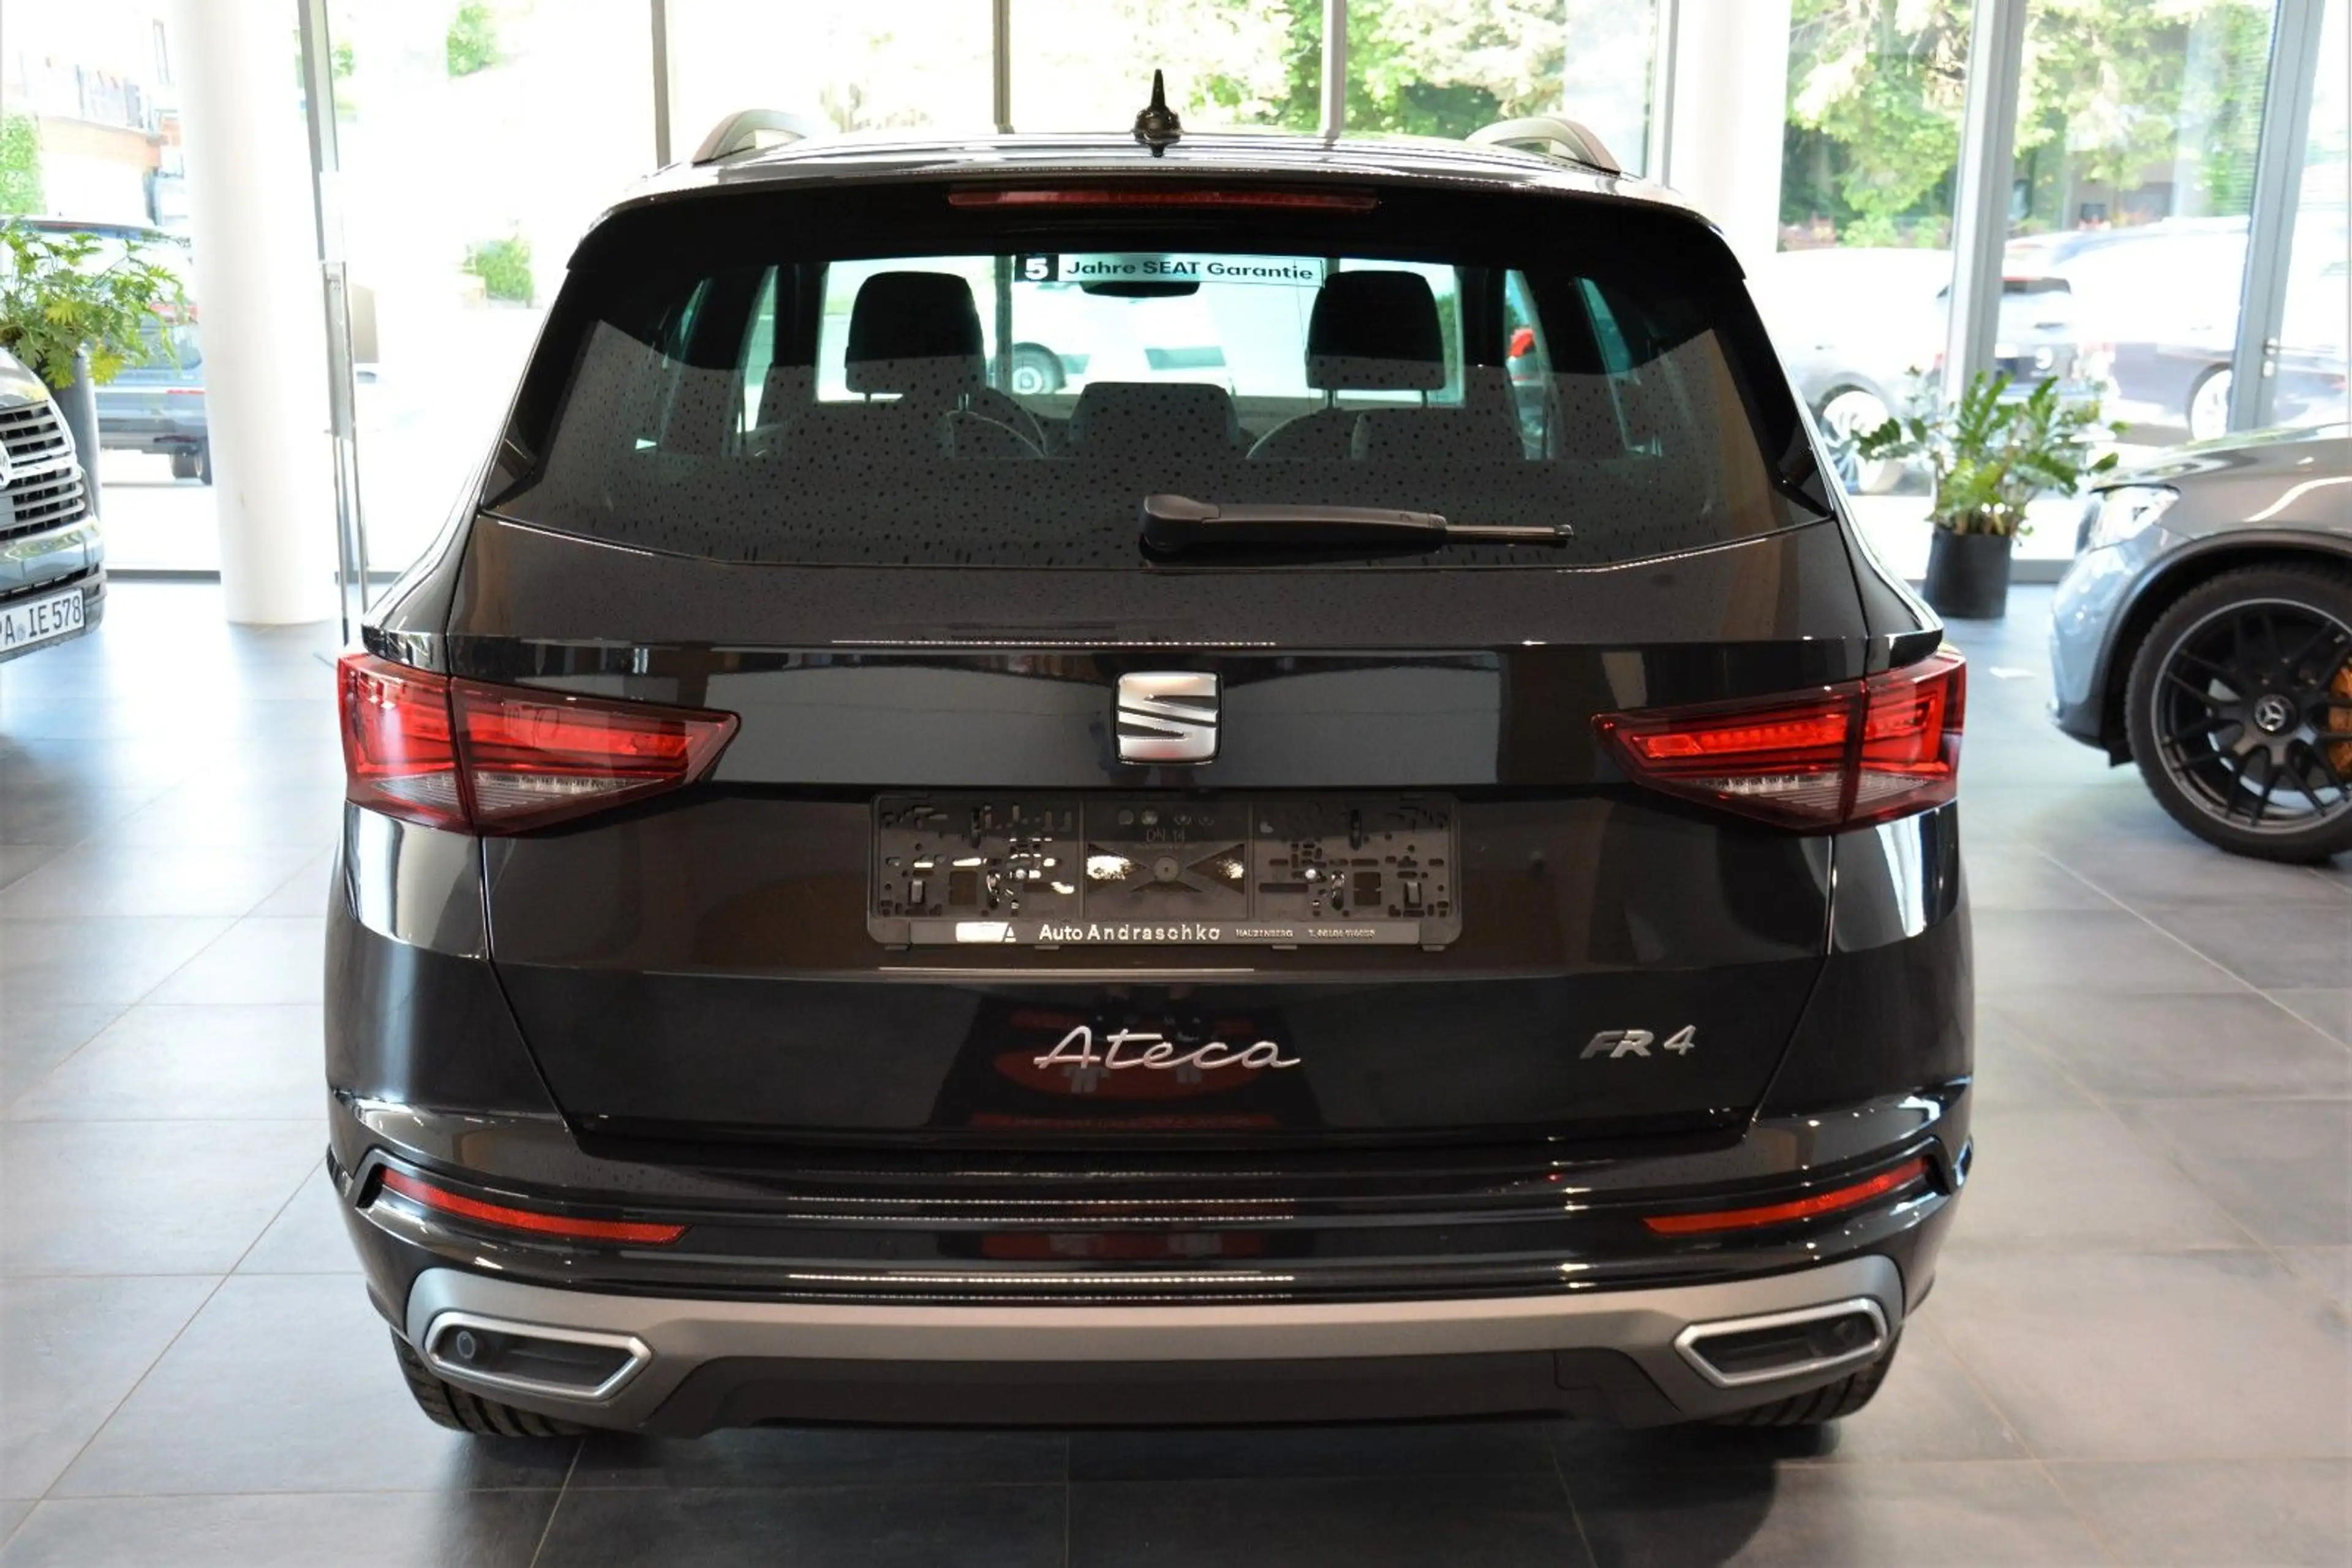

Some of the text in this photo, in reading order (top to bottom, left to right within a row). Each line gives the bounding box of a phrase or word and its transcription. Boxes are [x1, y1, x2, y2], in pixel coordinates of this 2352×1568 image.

[1024, 257, 1313, 280] 5 Jahre SEAT Garantie
[1039, 924, 1083, 941] Auto
[1033, 1025, 1300, 1069] Ateca
[1579, 1024, 1697, 1059] FR 4
